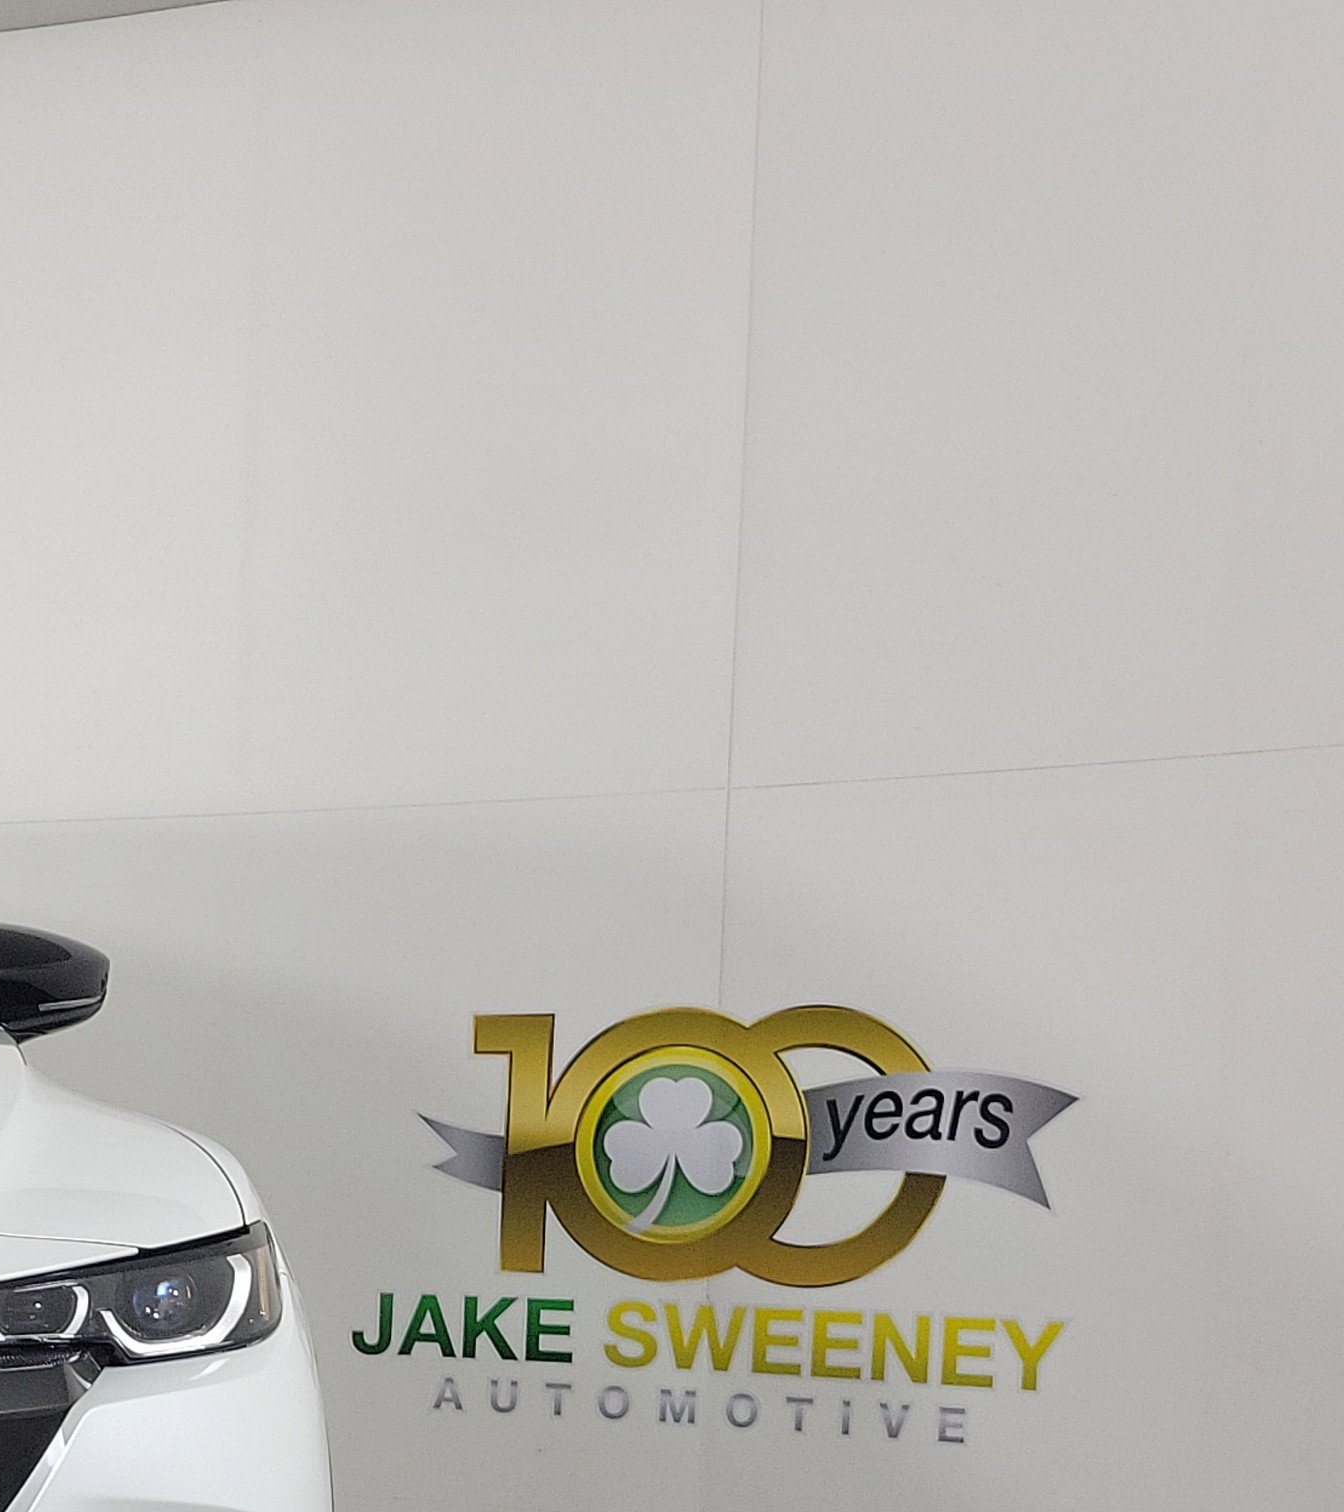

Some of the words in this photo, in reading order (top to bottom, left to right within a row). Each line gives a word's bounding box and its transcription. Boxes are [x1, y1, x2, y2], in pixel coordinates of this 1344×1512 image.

[473, 1004, 947, 1288] 100
[822, 1087, 1013, 1162] years
[351, 1292, 575, 1364] JAKE
[603, 1299, 1065, 1391] SWEENEY
[432, 1377, 967, 1444] AUTOMOTIVE
